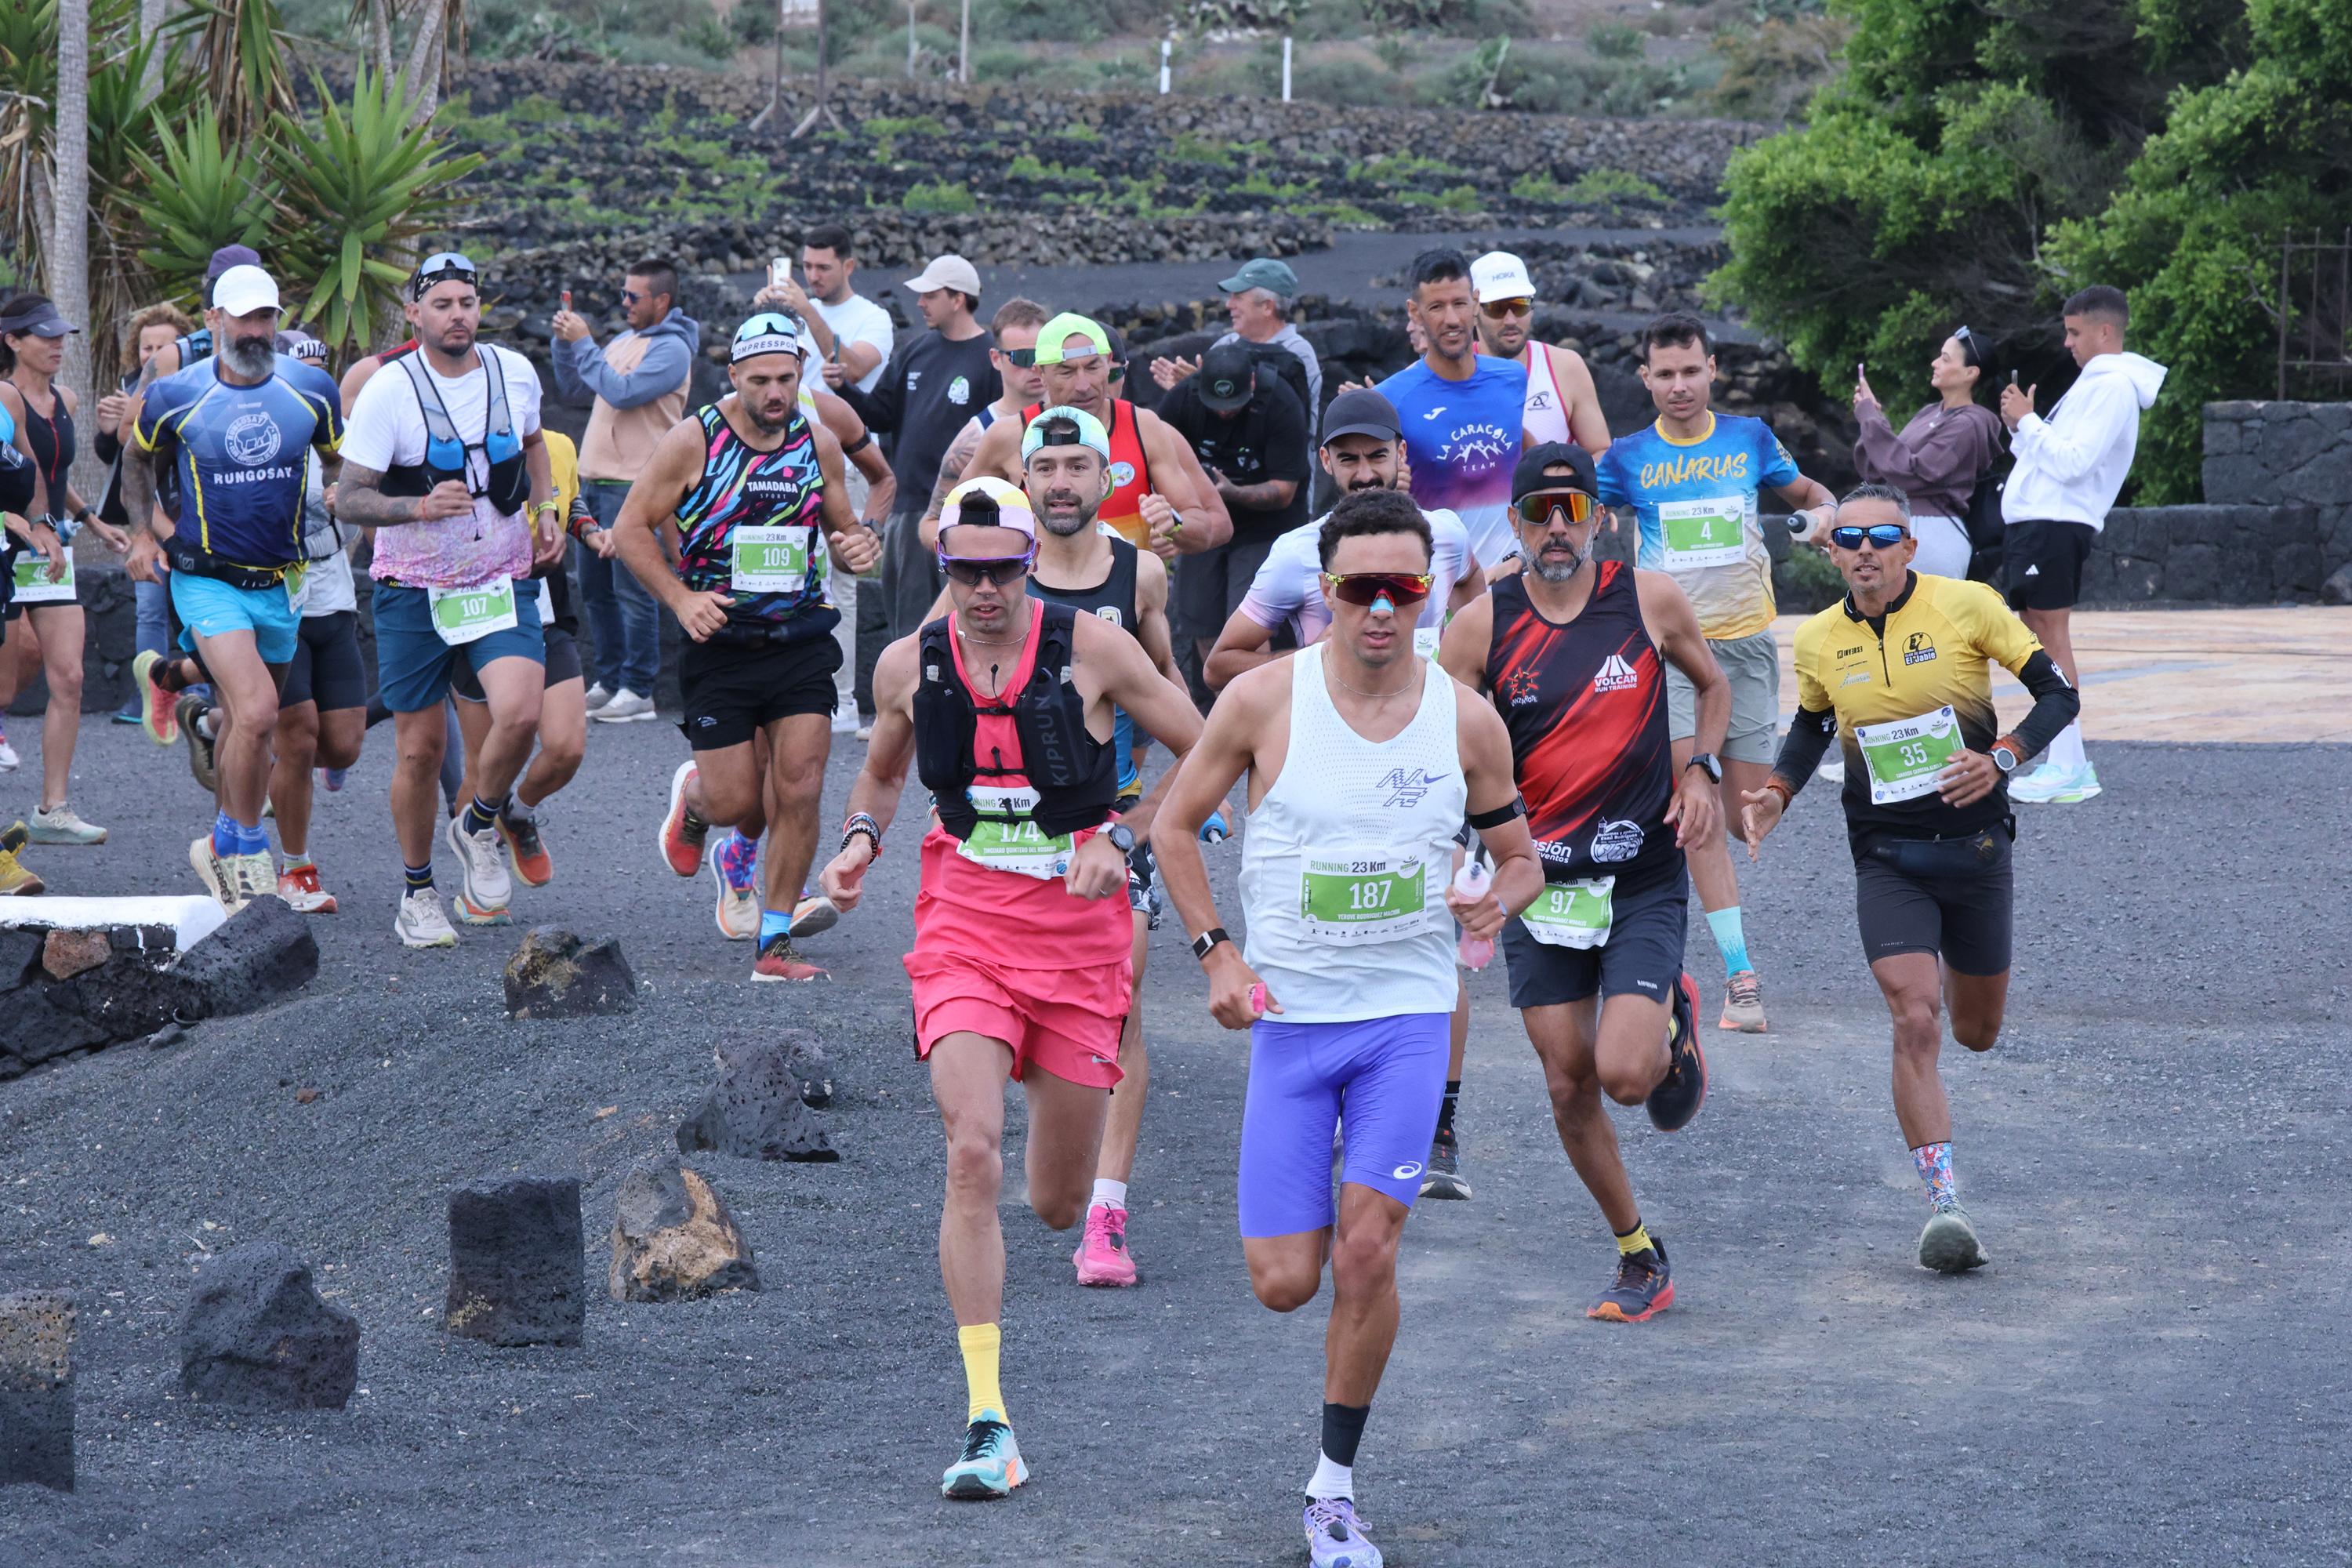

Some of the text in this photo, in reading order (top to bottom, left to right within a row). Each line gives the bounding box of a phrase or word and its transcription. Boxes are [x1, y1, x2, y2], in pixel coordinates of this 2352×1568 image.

[1436, 423, 1513, 460] LA CARACOLA
[213, 466, 292, 485] RUNGOSAY
[1463, 462, 1496, 472] TEAM
[1641, 452, 1748, 489] CANARIAS
[746, 481, 798, 493] TAMADABA
[1692, 507, 1702, 516] 23
[1700, 521, 1712, 540] 4
[763, 547, 790, 566] 109
[461, 597, 488, 617] 107
[1915, 652, 1936, 663] Jable
[1595, 675, 1638, 687] VOLCAN
[1608, 683, 1638, 691] TRAINING
[1035, 695, 1069, 786] KIPRUN
[1864, 733, 1891, 744] RUNNING
[1891, 729, 1905, 740] 23
[1905, 727, 1919, 738] Km
[1900, 742, 1928, 767] 35
[1014, 797, 1030, 808] Km
[1310, 860, 1386, 873] RUNNING 23 Km
[1349, 880, 1392, 909] 187
[1550, 890, 1576, 914] 97
